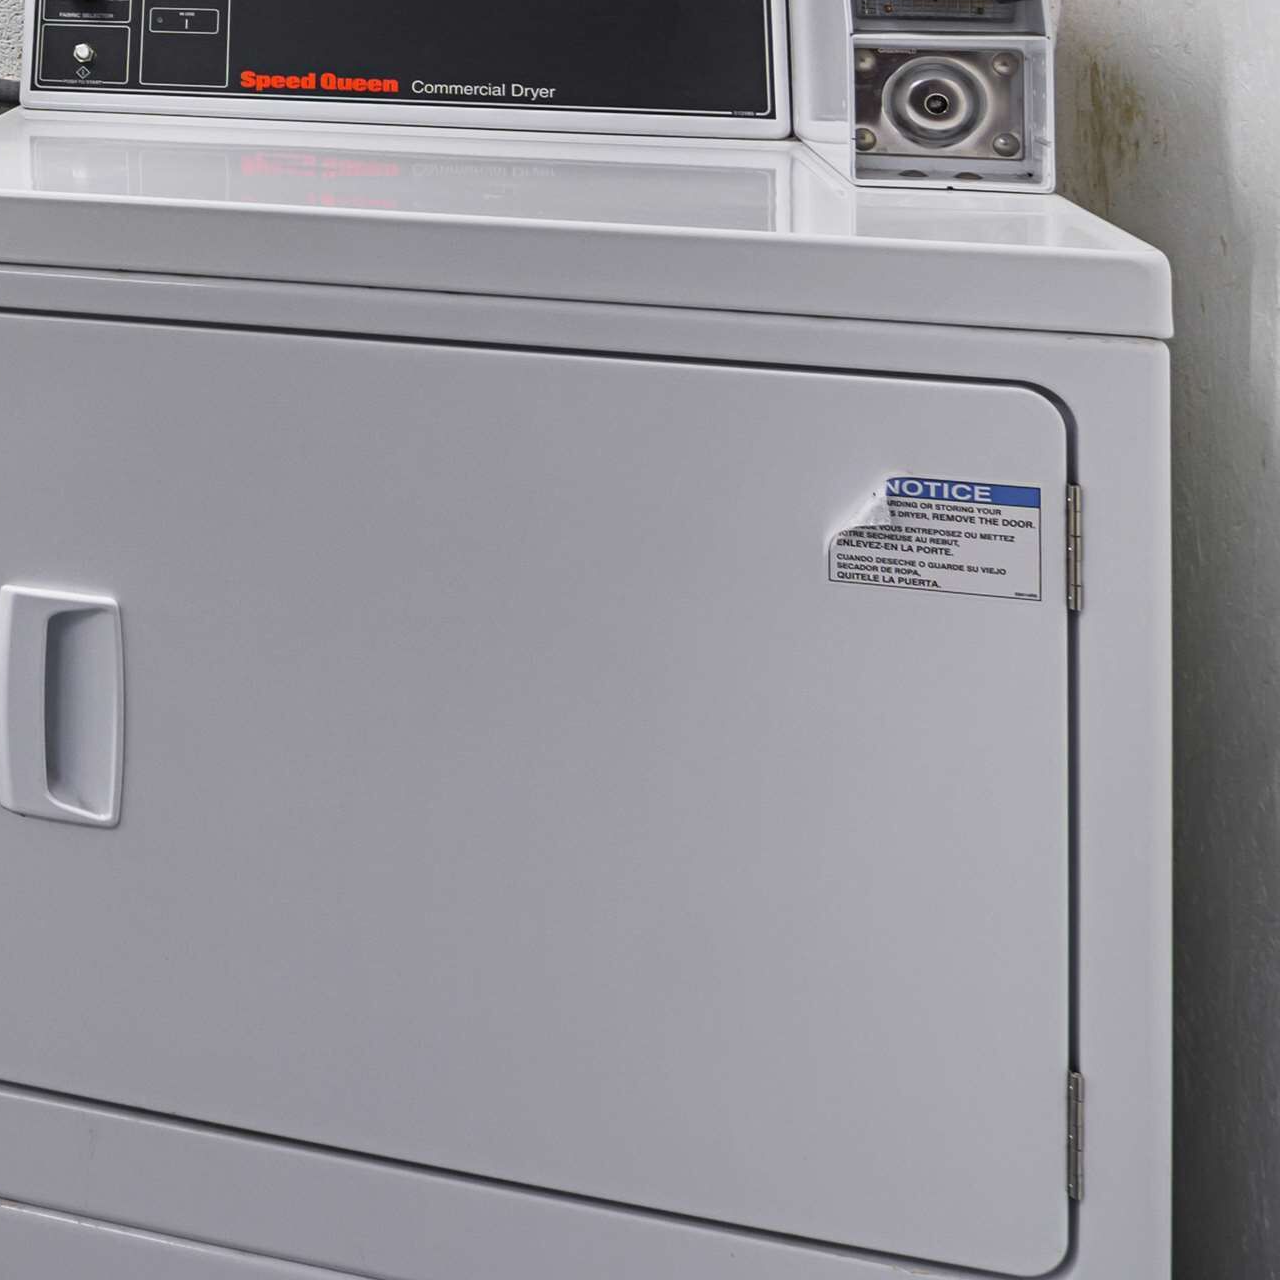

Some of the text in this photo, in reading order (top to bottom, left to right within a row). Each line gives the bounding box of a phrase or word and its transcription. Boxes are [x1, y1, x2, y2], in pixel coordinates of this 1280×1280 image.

[241, 70, 399, 93] Speed Queen
[411, 80, 556, 101] Commercial Dryer
[920, 502, 933, 510] OR
[935, 504, 974, 513] STORING
[976, 508, 1002, 516] YOUR
[932, 513, 975, 524] REMOVE
[978, 517, 999, 526] THE
[905, 527, 962, 538] ENTREPOSEZ
[964, 531, 977, 539] OU
[980, 533, 1015, 542] METTEZ
[915, 536, 927, 544] AU
[836, 538, 954, 556] ENLEVEZ-EN LA PORTE.
[836, 553, 873, 563] CUANDO
[928, 561, 964, 572] GUARDE
[966, 565, 978, 573] SU
[981, 567, 1007, 575] VIEJO
[836, 562, 878, 572] SECADOR
[836, 571, 941, 588] QUITELE LA PUERTA.
